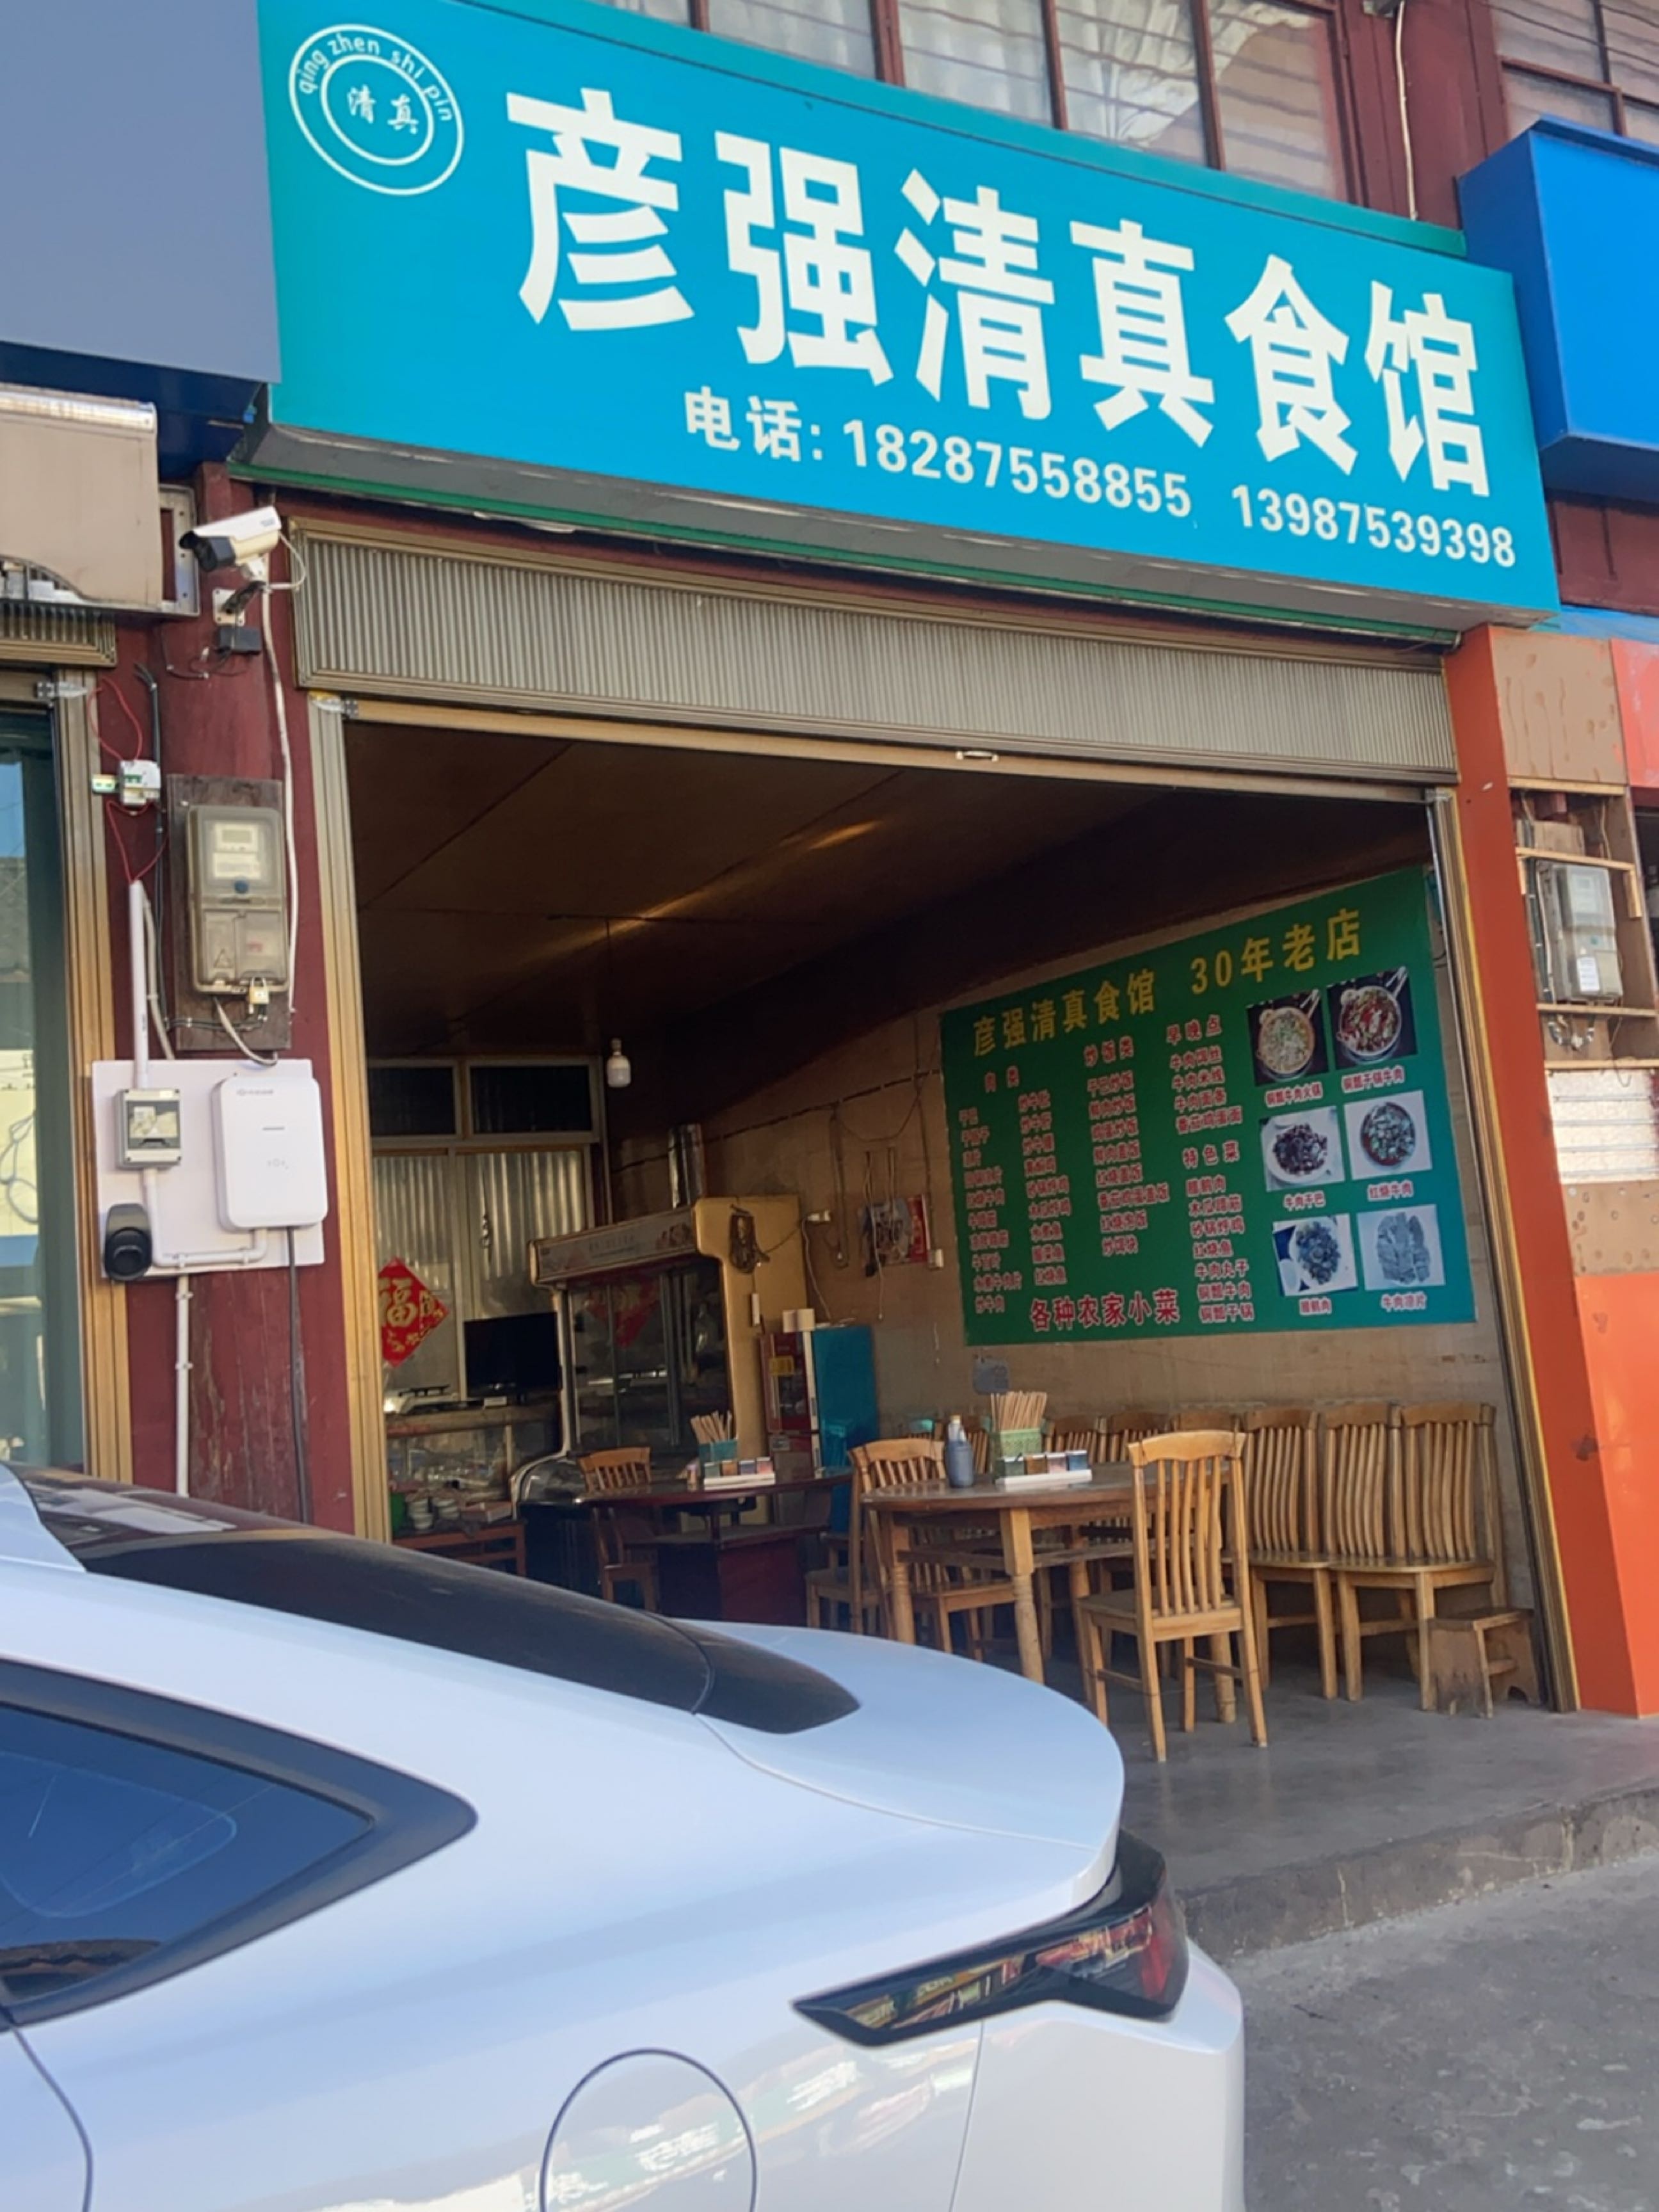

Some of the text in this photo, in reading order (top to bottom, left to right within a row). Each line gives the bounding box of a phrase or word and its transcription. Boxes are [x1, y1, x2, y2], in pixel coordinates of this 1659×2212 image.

[297, 32, 453, 120] qing zhen shi pin
[347, 84, 419, 134] 清真
[506, 88, 1489, 497] 彦强清真食馆
[843, 419, 1192, 518] 18287558855
[1231, 485, 1516, 568] 13987539398
[974, 908, 1360, 1056] 彦强清真食馆 30年老店
[1173, 1064, 1224, 1090] 牛肉米线
[1196, 1259, 1249, 1279] 牛肉丸子
[1030, 1288, 1180, 1332] 各种农家小菜
